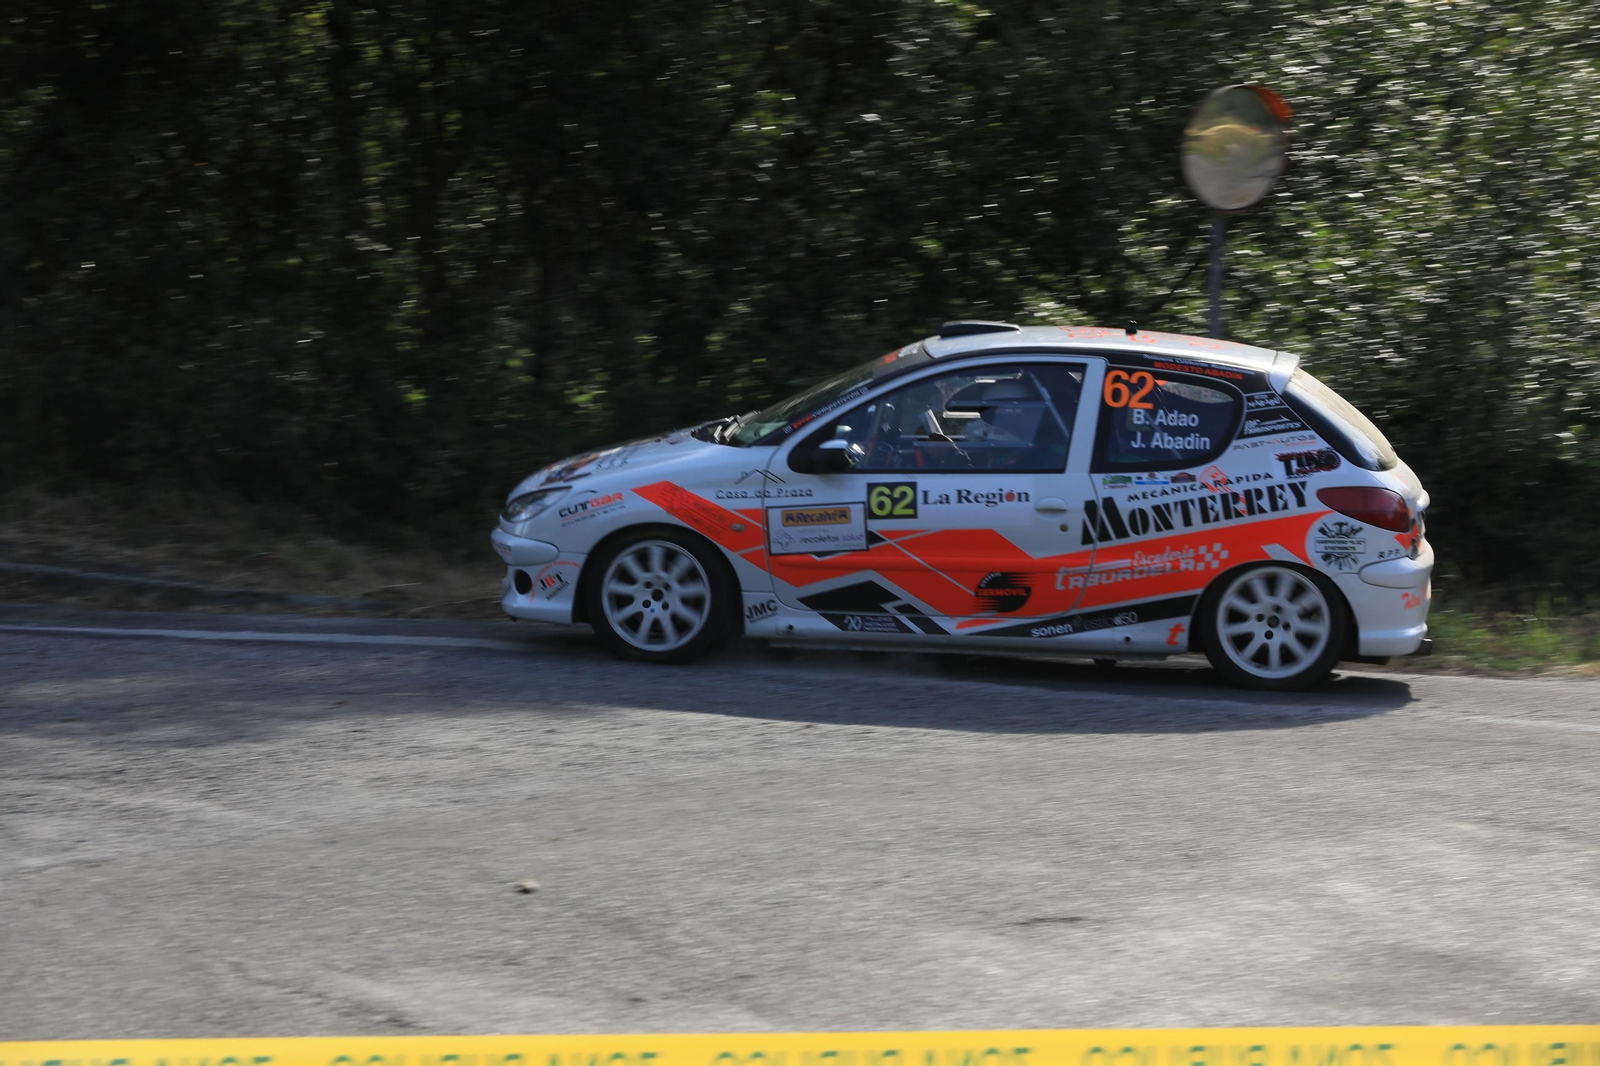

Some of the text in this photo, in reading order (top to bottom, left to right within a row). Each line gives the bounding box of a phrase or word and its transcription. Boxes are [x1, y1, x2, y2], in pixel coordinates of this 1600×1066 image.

[1104, 370, 1155, 410] 62
[1132, 409, 1199, 427] B. Adao
[1131, 432, 1211, 450] J. Abadin
[715, 487, 813, 499] Casa da Praza
[869, 485, 915, 516] 62
[921, 488, 1031, 507] La Región
[796, 510, 837, 523] Recalvi
[1081, 481, 1307, 545] MONTERREY
[800, 534, 840, 544] recoletas
[977, 588, 1028, 597] SERMOVIL
[746, 599, 778, 620] JMC
[1031, 622, 1073, 638] sonen
